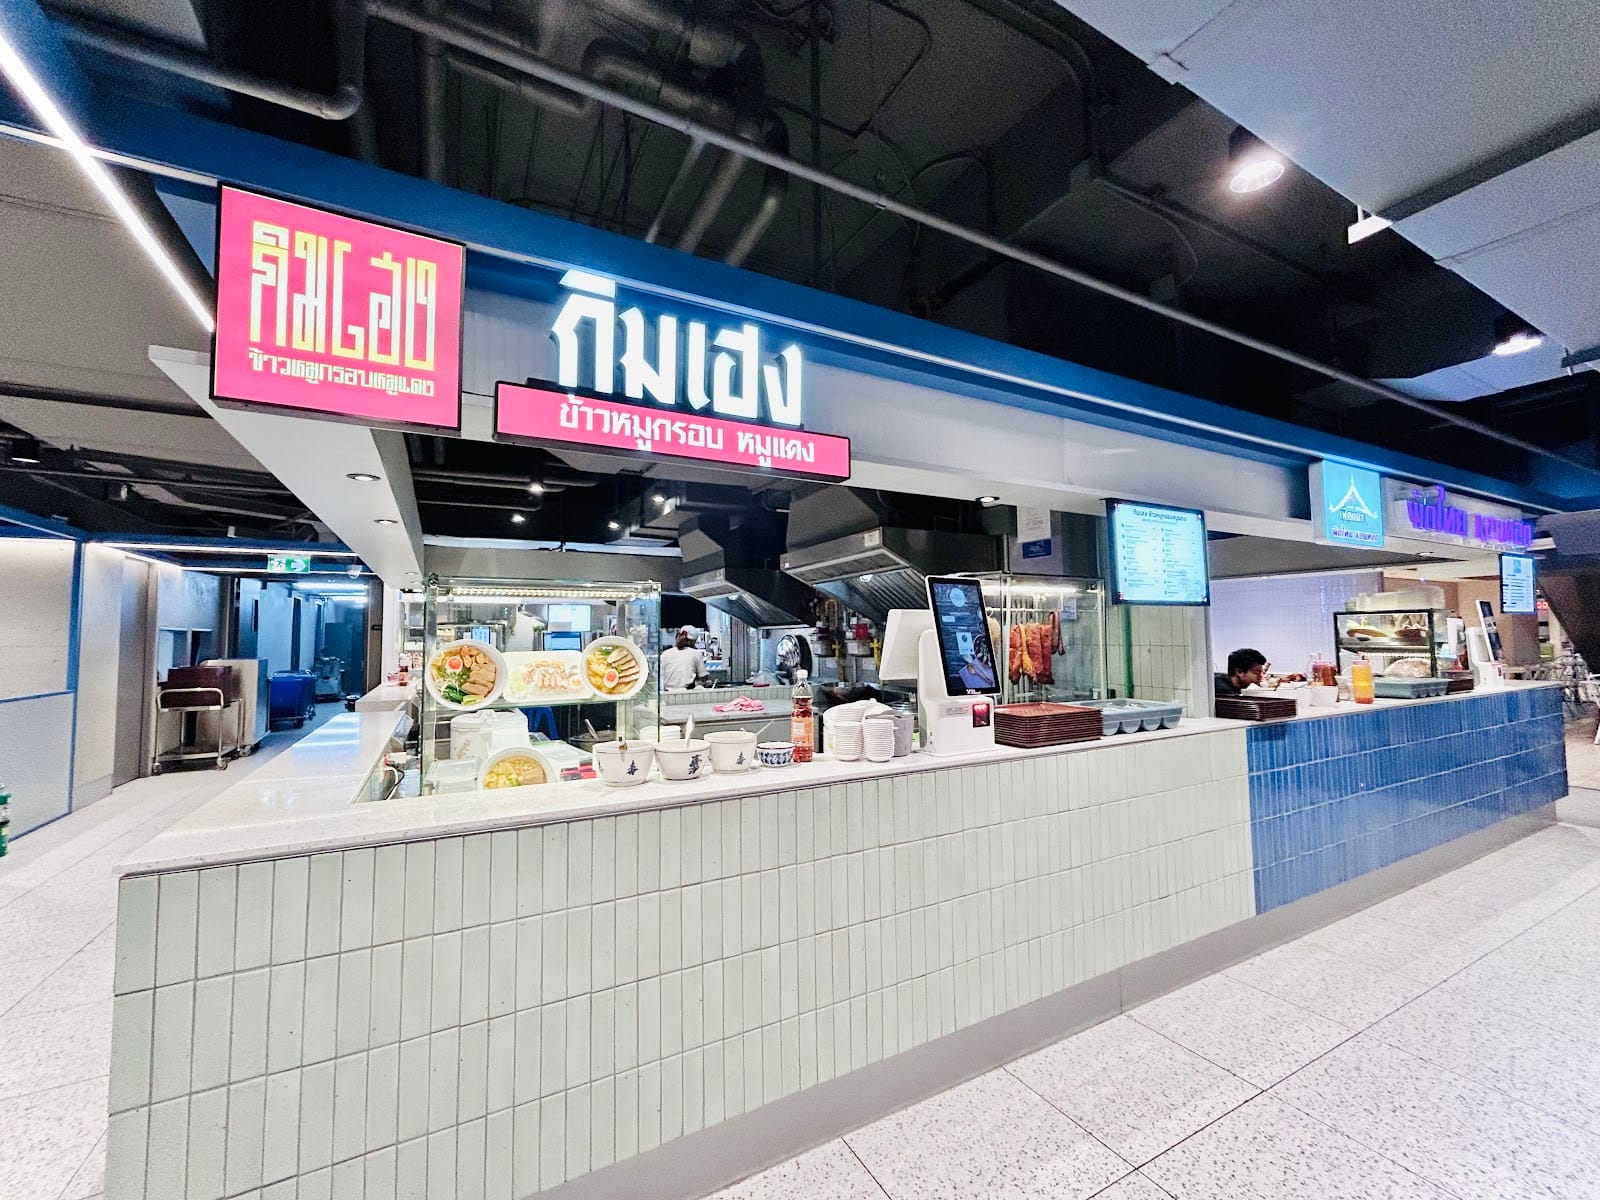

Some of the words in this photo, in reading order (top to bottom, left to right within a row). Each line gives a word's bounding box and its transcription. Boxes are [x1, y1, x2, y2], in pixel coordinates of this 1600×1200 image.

[250, 220, 436, 371] กิมเฮง
[551, 269, 802, 426] กิมเฮง
[248, 347, 435, 397] ข้าวหมูกรอบหมูแดง
[560, 394, 724, 452] ข้าวหมูกรอบ
[737, 430, 815, 469] หมูแดง
